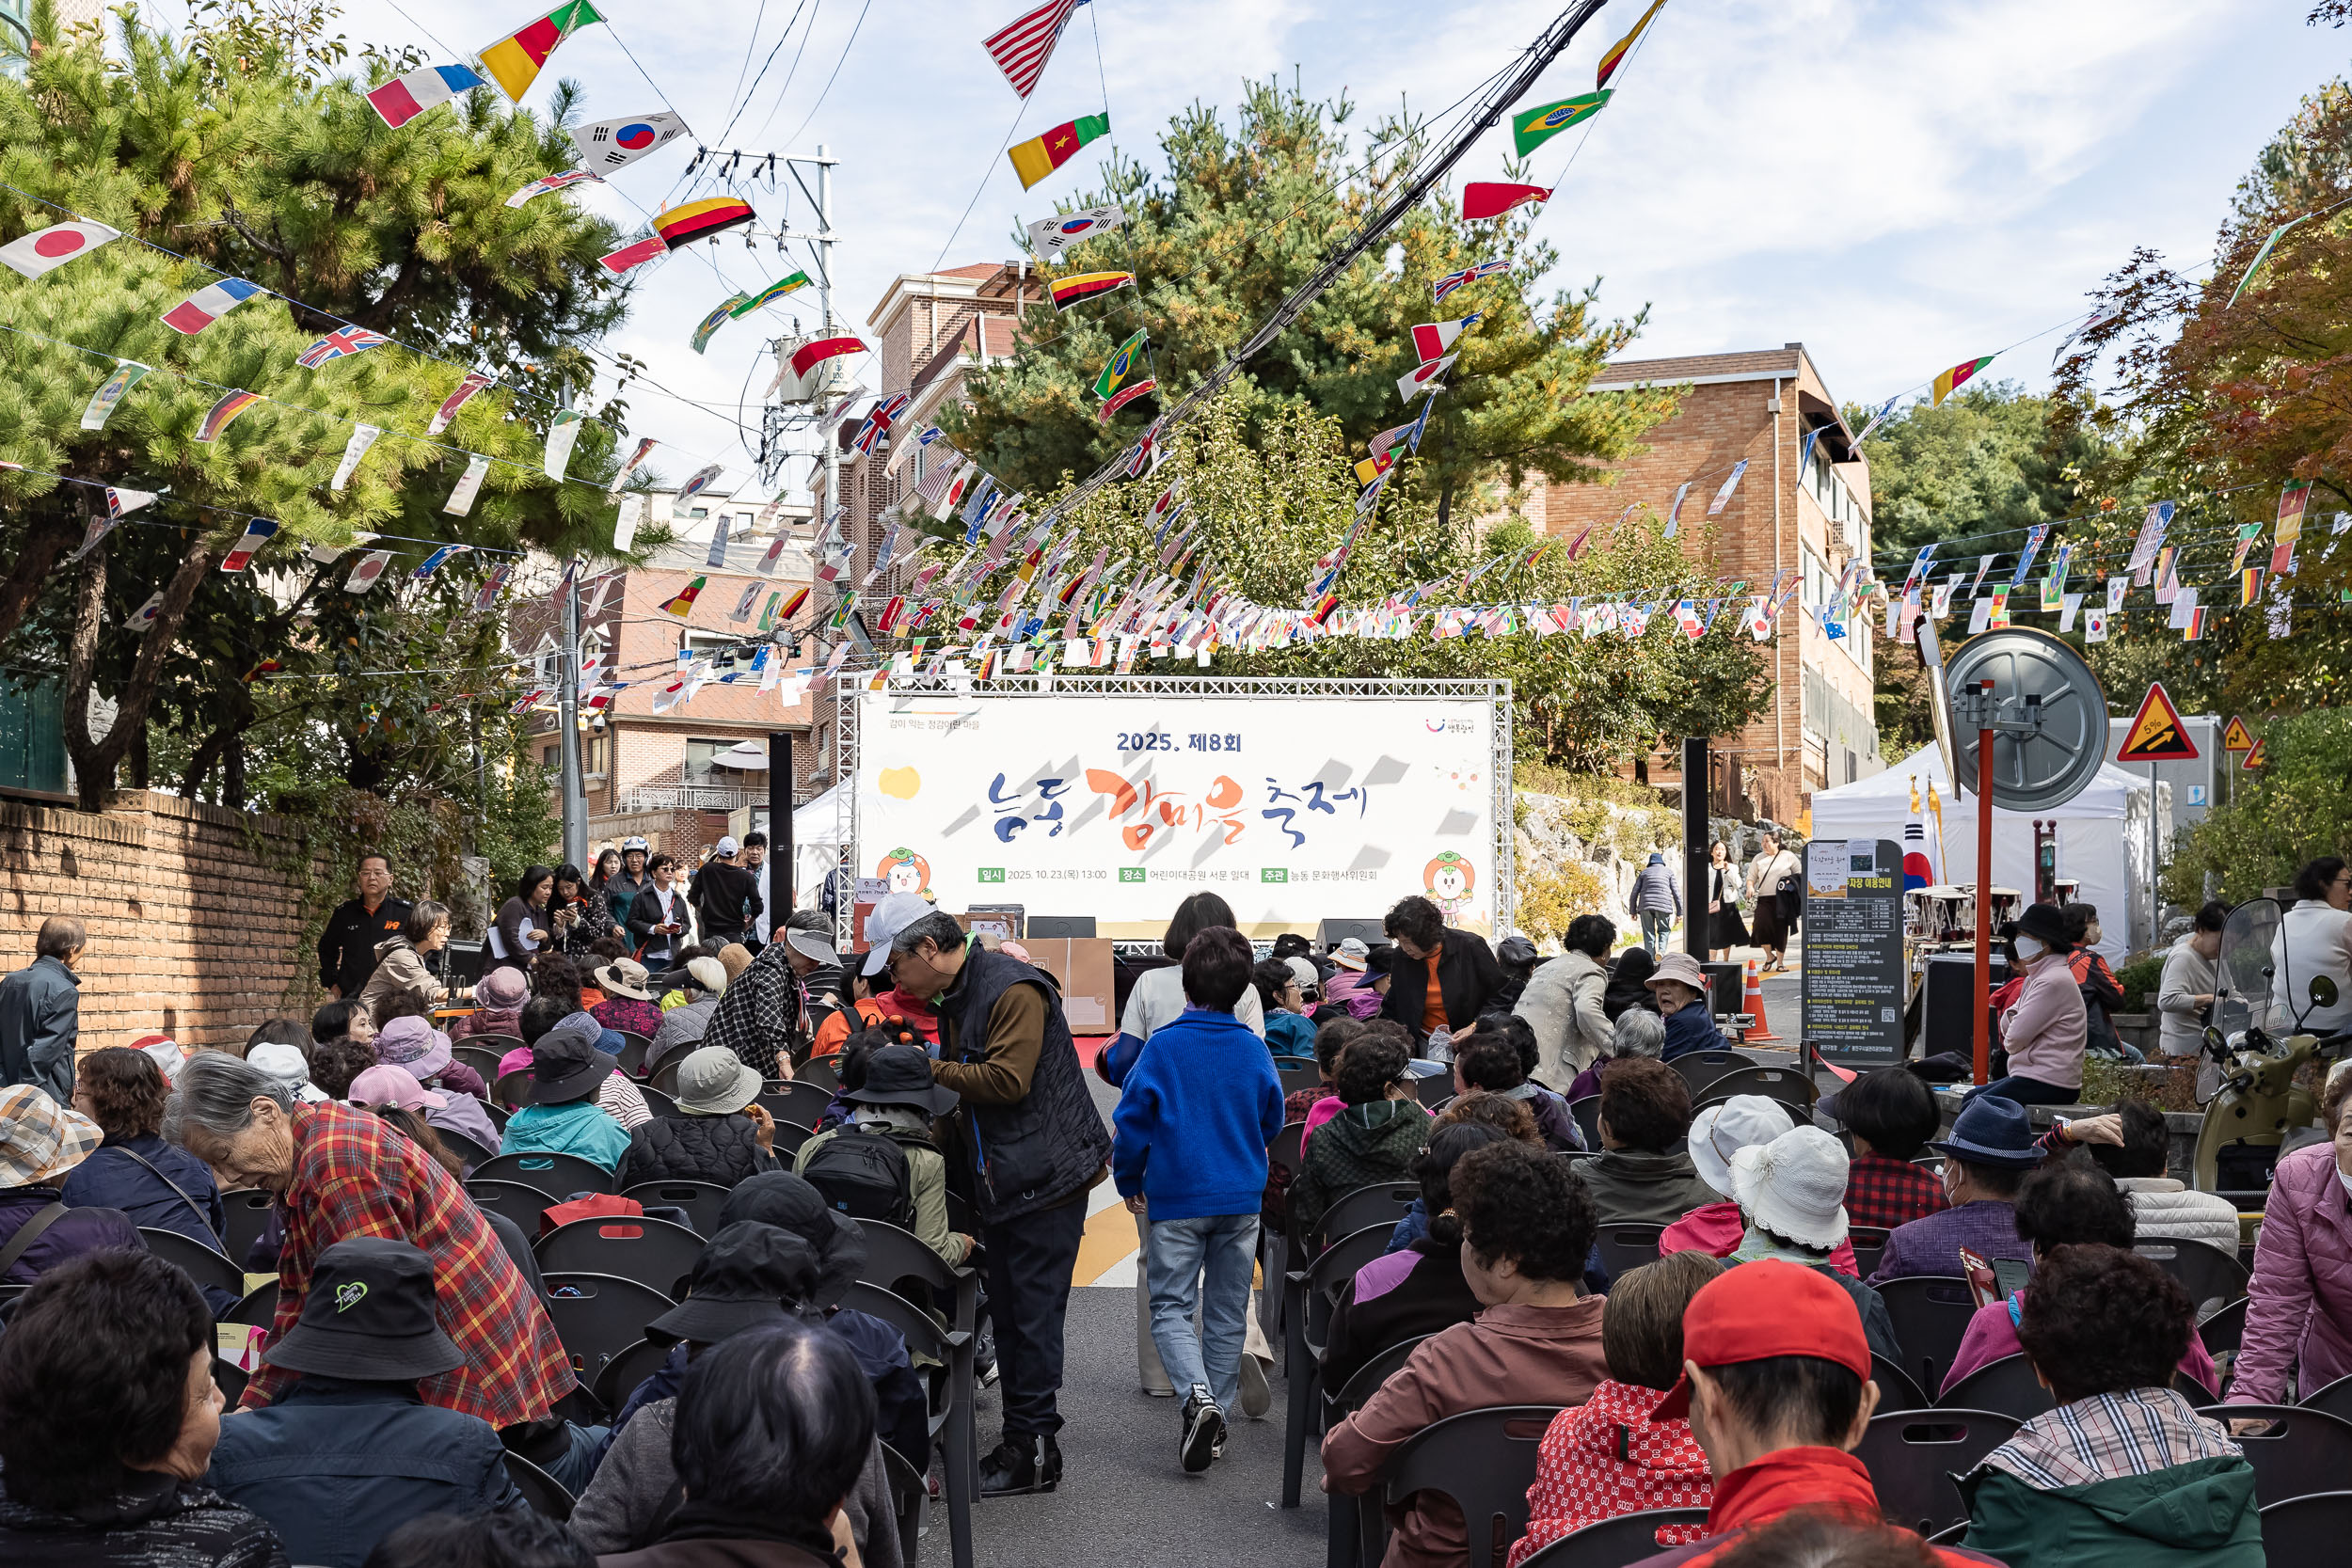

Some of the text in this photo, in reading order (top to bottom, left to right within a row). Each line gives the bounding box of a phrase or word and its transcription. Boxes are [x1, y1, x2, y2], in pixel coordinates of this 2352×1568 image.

[890, 720, 979, 730] 감이 익는 정감어린 마을
[2143, 719, 2162, 735] 5%
[1117, 732, 1241, 752] 2025. 제8회
[988, 768, 1367, 851] 능동 감마을 축제
[981, 869, 1002, 881] 일시
[1008, 870, 1033, 879] 2025.
[1036, 870, 1049, 879] 10.
[1082, 870, 1107, 879] 13:00
[1122, 869, 1249, 881] 장소 어린이대공원 서문 일대
[1263, 870, 1377, 881] 주관 능동 문화행사위원회
[1865, 878, 1892, 889] 이용안내
[1444, 899, 1453, 911] J
[384, 920, 401, 930] 119
[1619, 1476, 1636, 1488] GDGD
[1617, 1500, 1634, 1512] GDGD
